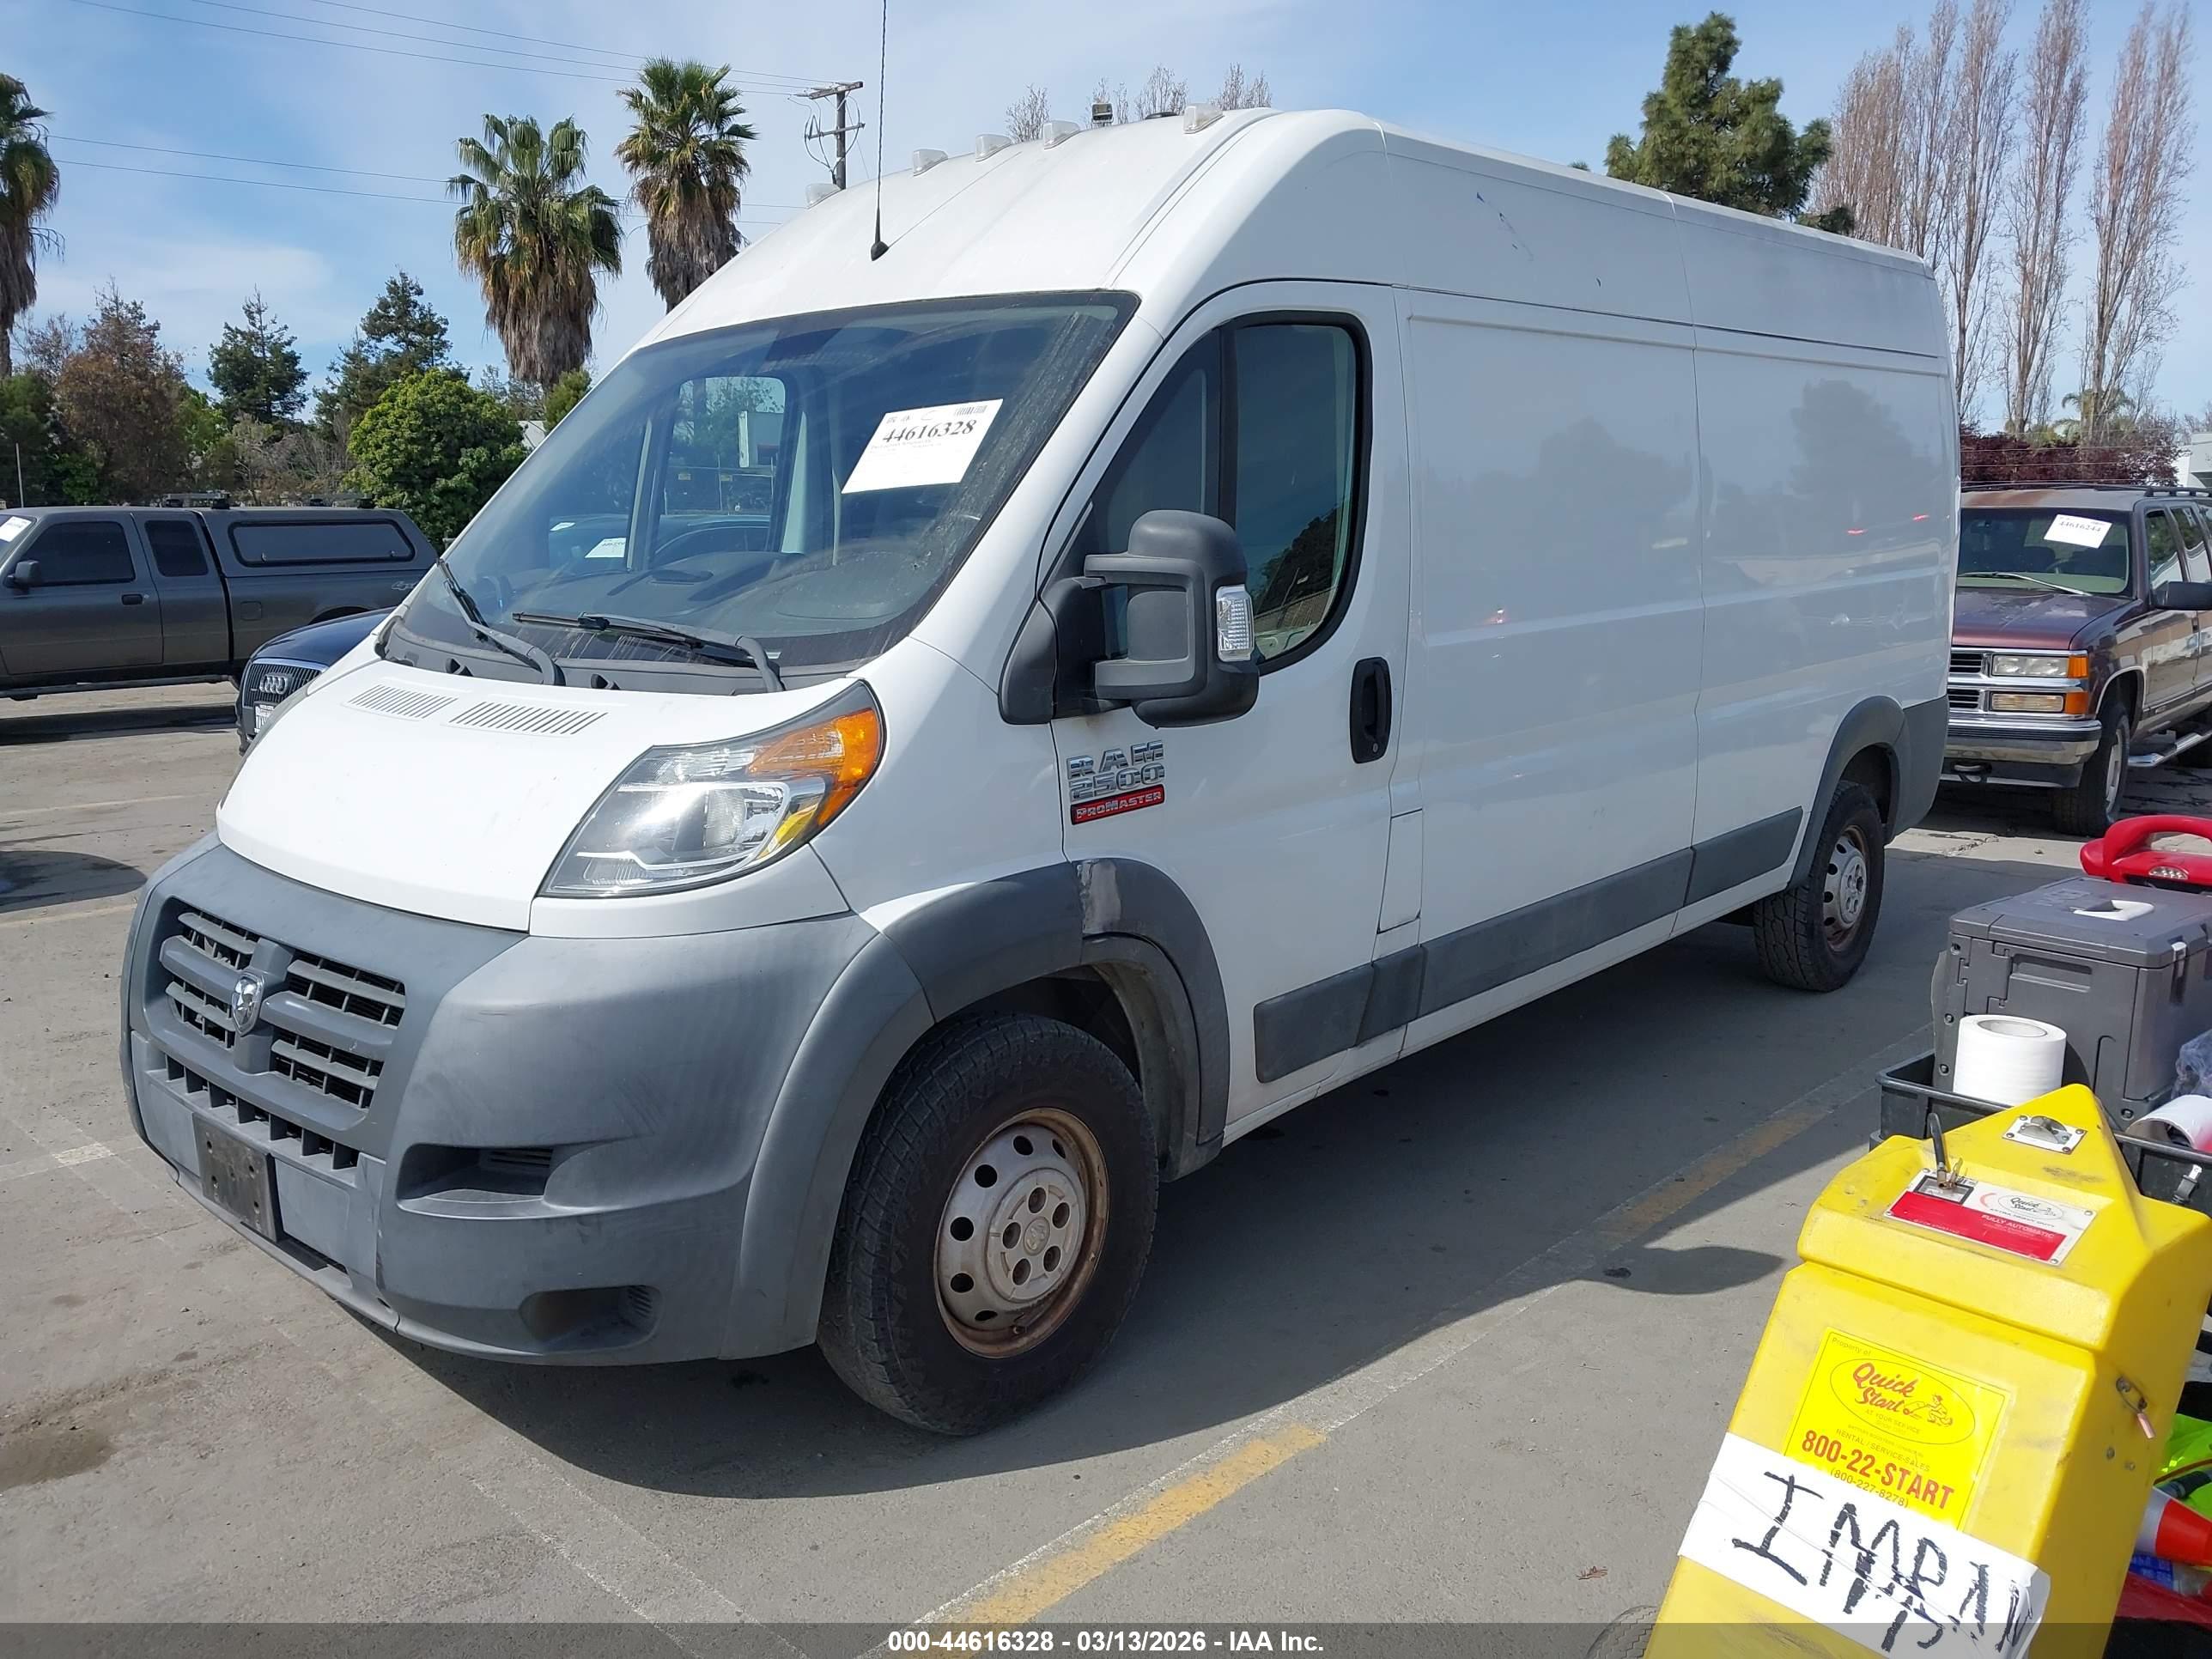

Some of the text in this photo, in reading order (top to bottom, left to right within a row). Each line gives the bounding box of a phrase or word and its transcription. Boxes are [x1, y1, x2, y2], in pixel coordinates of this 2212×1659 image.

[882, 419, 977, 443] 44616328
[1066, 739, 1165, 780] RAM
[1068, 763, 1166, 803] 2500
[2006, 1222, 2055, 1238] AUTOMATIC
[1832, 1337, 1862, 1356] Property
[1852, 1362, 1919, 1398] Quick
[1855, 1387, 1905, 1413] Start
[1875, 1413, 1893, 1424] YOUR
[1893, 1418, 1922, 1435] SERVICE
[1836, 1428, 1865, 1447] RENTAL
[1802, 1429, 1955, 1510] 800-22-START
[1830, 1468, 1910, 1509] (800-227-8278)
